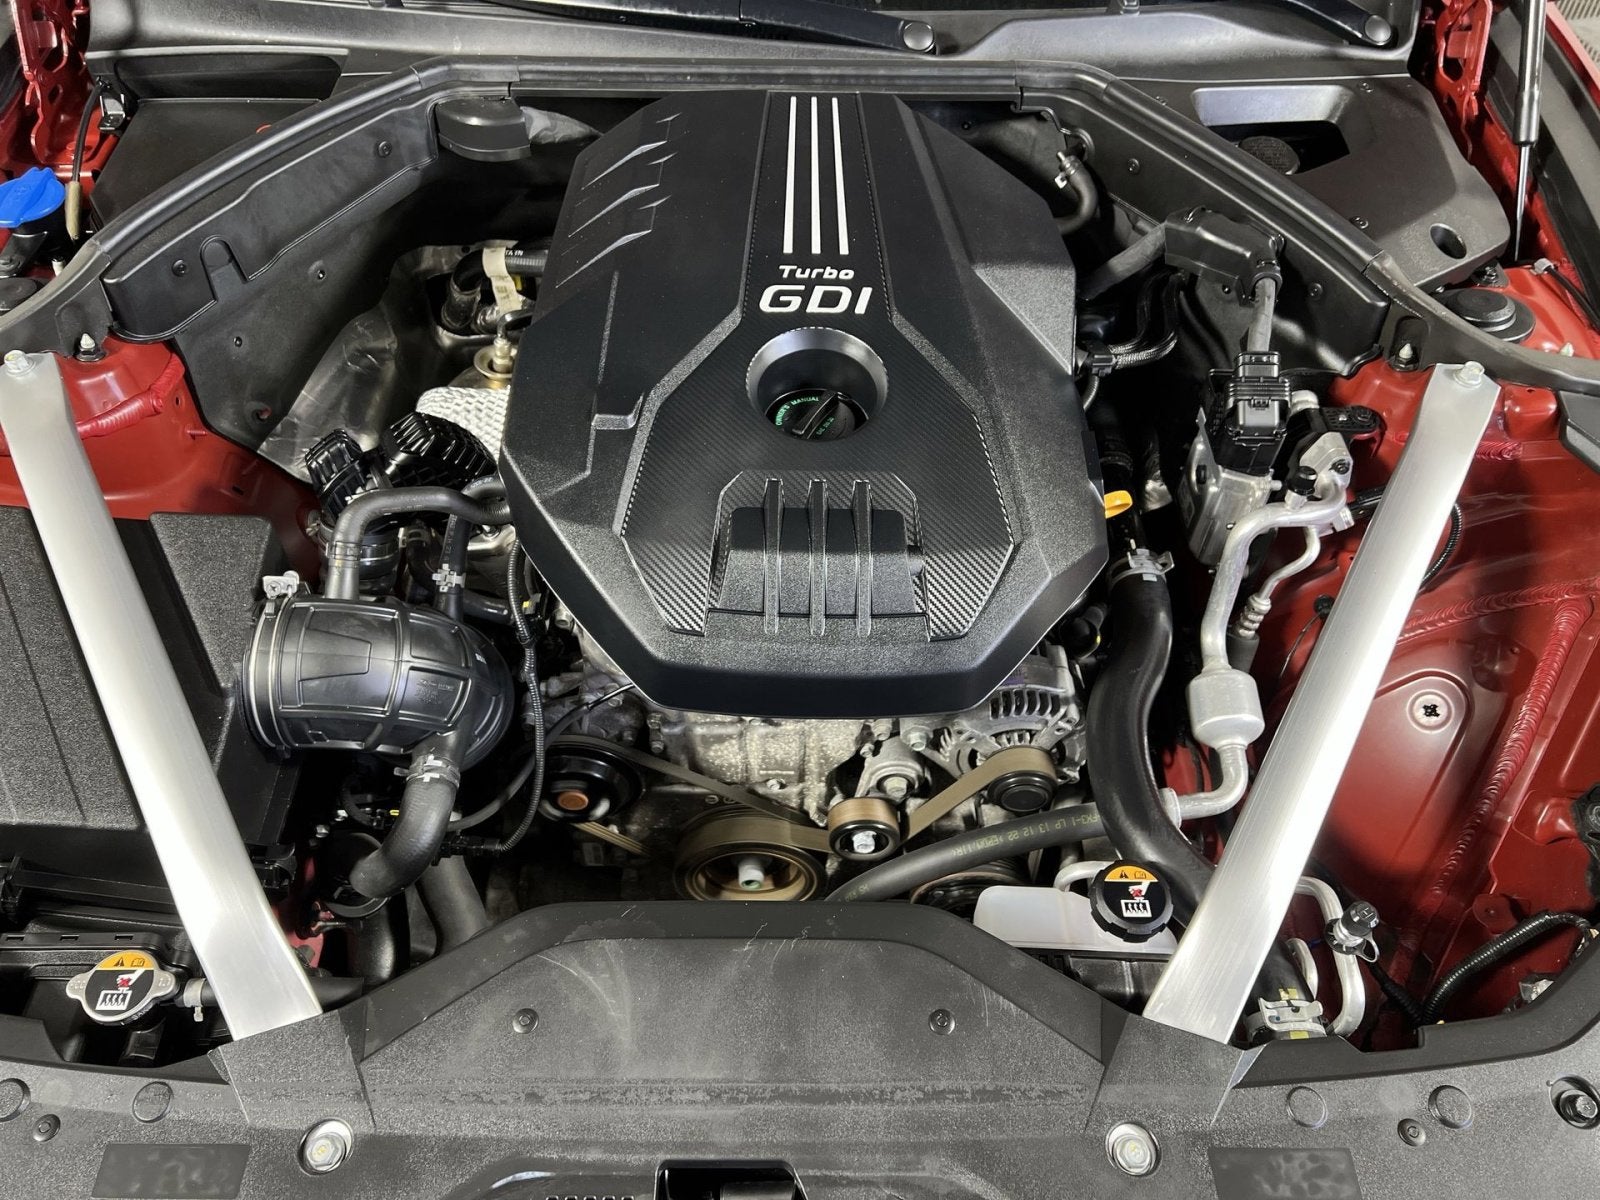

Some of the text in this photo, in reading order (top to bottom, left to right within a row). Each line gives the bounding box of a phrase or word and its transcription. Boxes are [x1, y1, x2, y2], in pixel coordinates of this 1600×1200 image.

[778, 264, 855, 280] Turbo
[759, 284, 873, 315] GDI
[775, 396, 819, 426] OWNER'S MANUAL
[1008, 829, 1020, 841] 22
[1023, 826, 1035, 837] 12
[1038, 822, 1050, 834] 13
